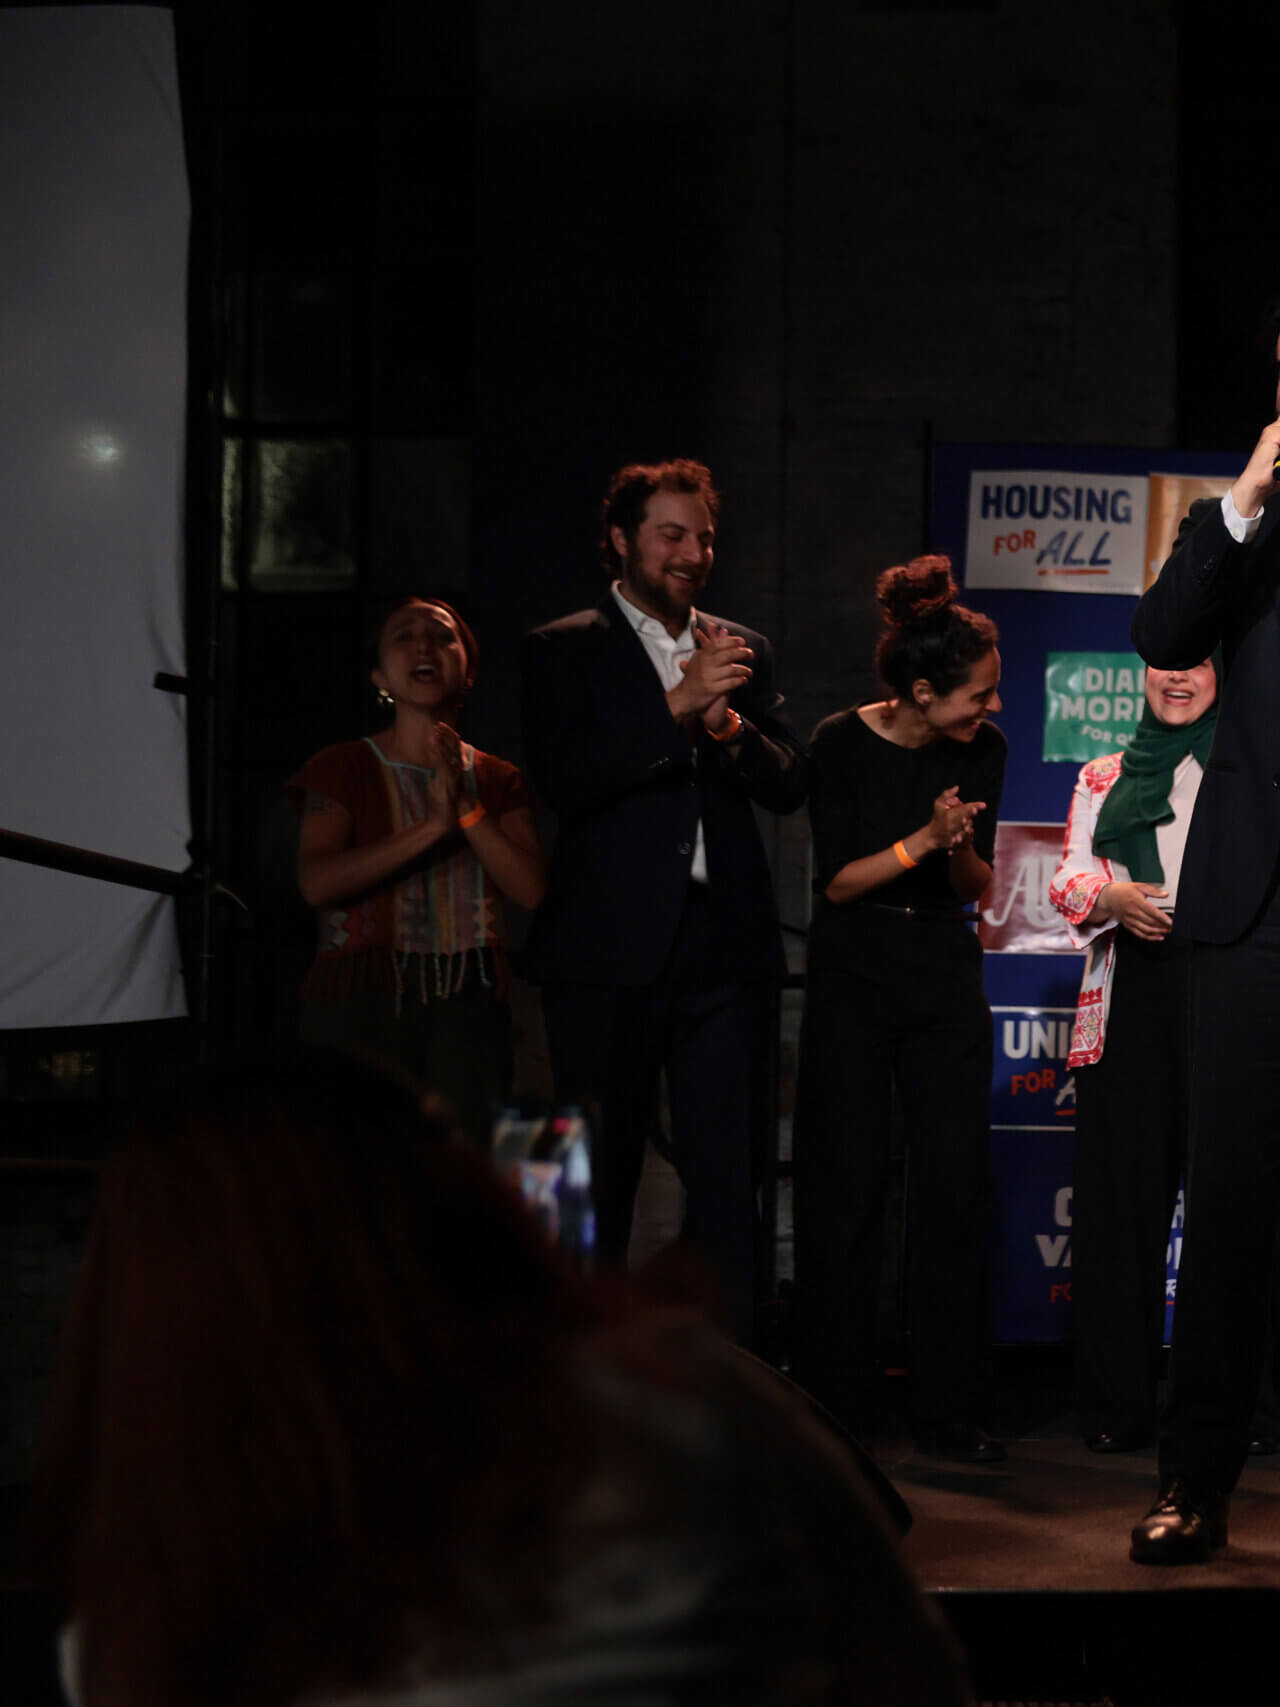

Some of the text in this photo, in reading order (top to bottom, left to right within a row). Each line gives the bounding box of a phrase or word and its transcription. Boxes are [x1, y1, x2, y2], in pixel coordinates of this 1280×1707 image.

[981, 484, 1132, 524] HOUSING
[993, 529, 1112, 566] FOR ALL
[1085, 668, 1146, 692] DIA
[1081, 725, 1112, 742] FOR
[1003, 1020, 1069, 1059] UNI
[1010, 1068, 1056, 1096] FOR
